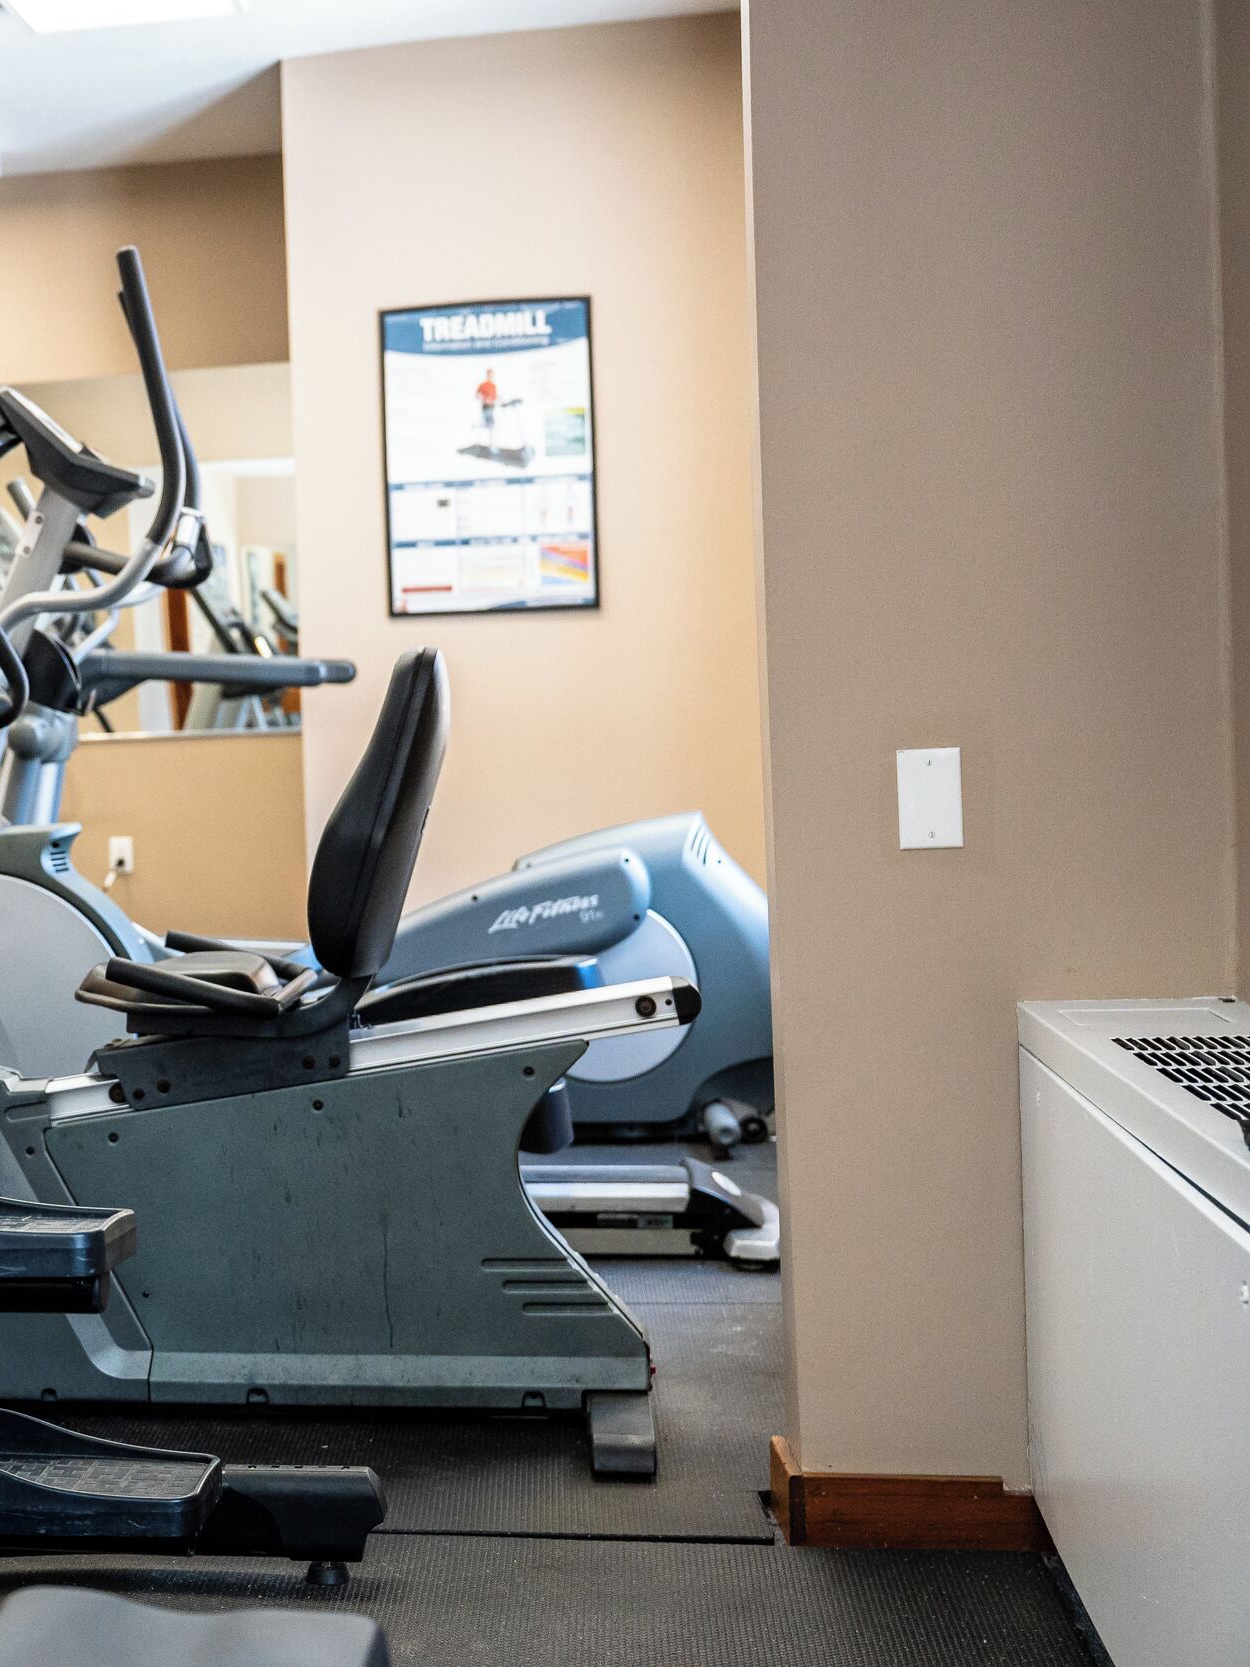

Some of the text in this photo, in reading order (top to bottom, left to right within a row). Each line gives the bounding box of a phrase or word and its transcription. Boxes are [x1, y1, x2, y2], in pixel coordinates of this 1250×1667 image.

[419, 309, 553, 342] TREADMILL
[488, 894, 599, 935] Life Fitness
